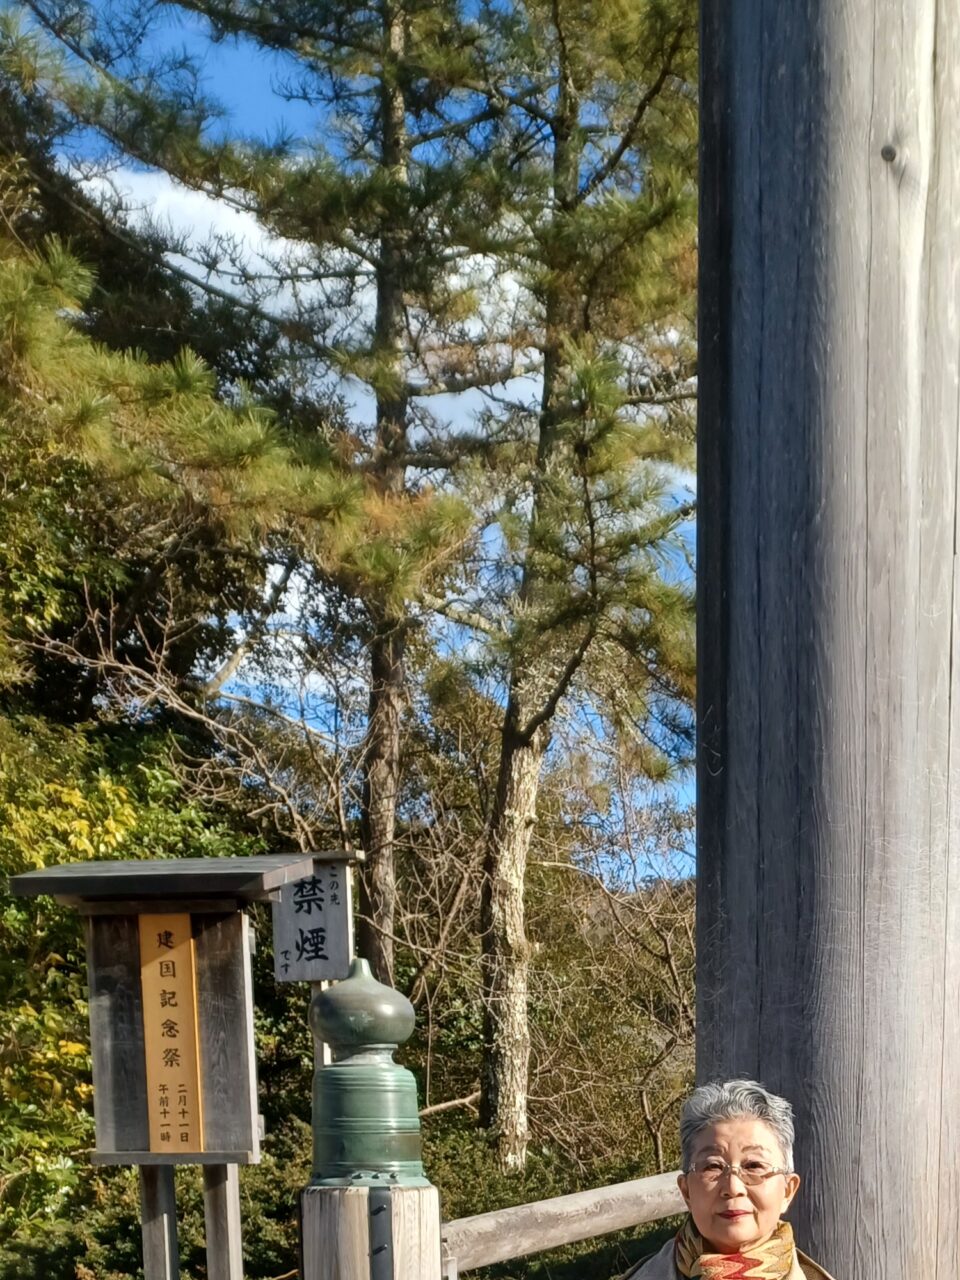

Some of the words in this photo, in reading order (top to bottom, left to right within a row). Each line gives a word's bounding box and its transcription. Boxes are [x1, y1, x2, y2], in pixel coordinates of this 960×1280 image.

[293, 876, 329, 962] 禁煙
[156, 929, 181, 1067] 建国記念祭
[158, 1083, 171, 1143] 午前十一時
[177, 1083, 190, 1143] 二月十一日
